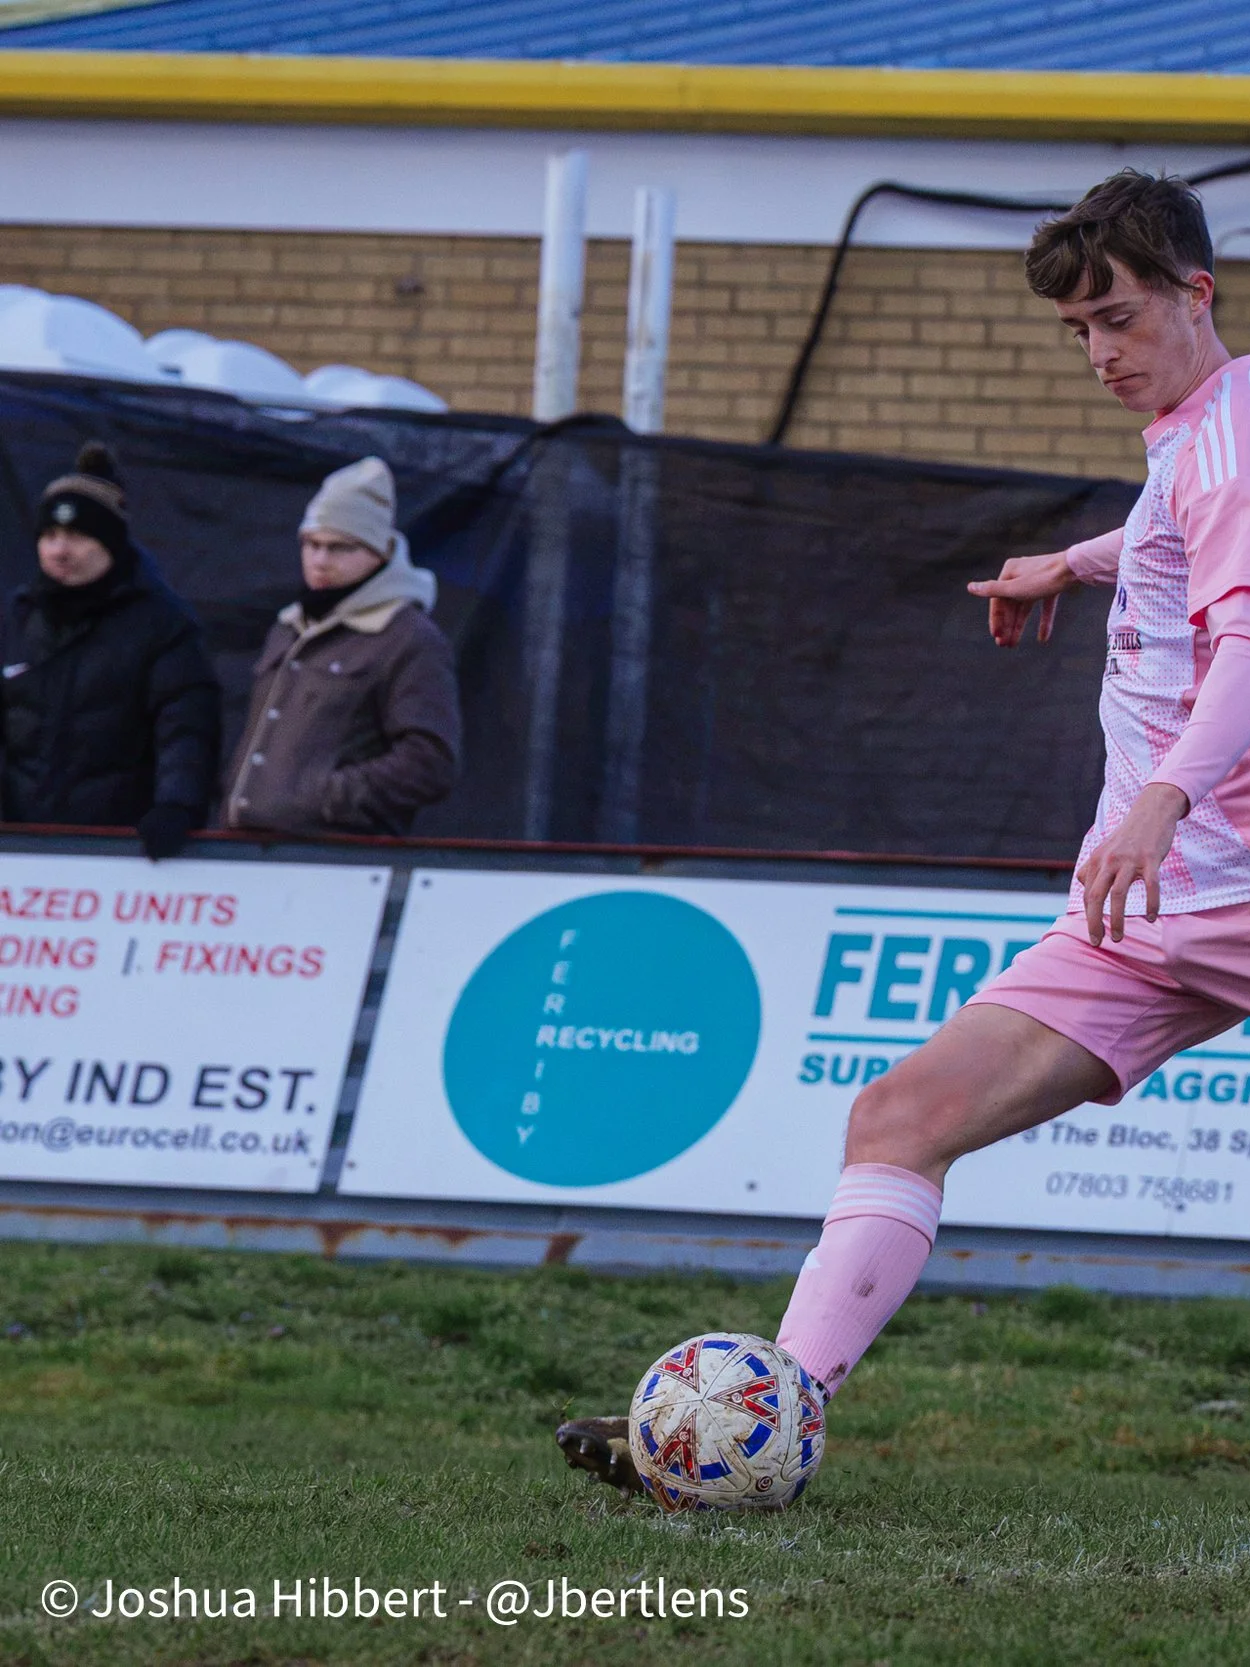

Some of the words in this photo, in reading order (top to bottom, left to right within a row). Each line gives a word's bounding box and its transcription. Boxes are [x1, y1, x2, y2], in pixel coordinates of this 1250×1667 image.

[113, 890, 237, 926] UNITS
[155, 941, 326, 979] FIXINGS
[0, 983, 80, 1018] ING
[536, 1024, 700, 1055] RECYCLING
[0, 1056, 51, 1102] Y
[65, 1059, 171, 1106] IND
[191, 1064, 317, 1114] EST.
[1050, 1121, 1099, 1145] The
[1107, 1123, 1178, 1152] Bloc,
[1187, 1128, 1222, 1153] 38
[1045, 1171, 1130, 1199] 07803
